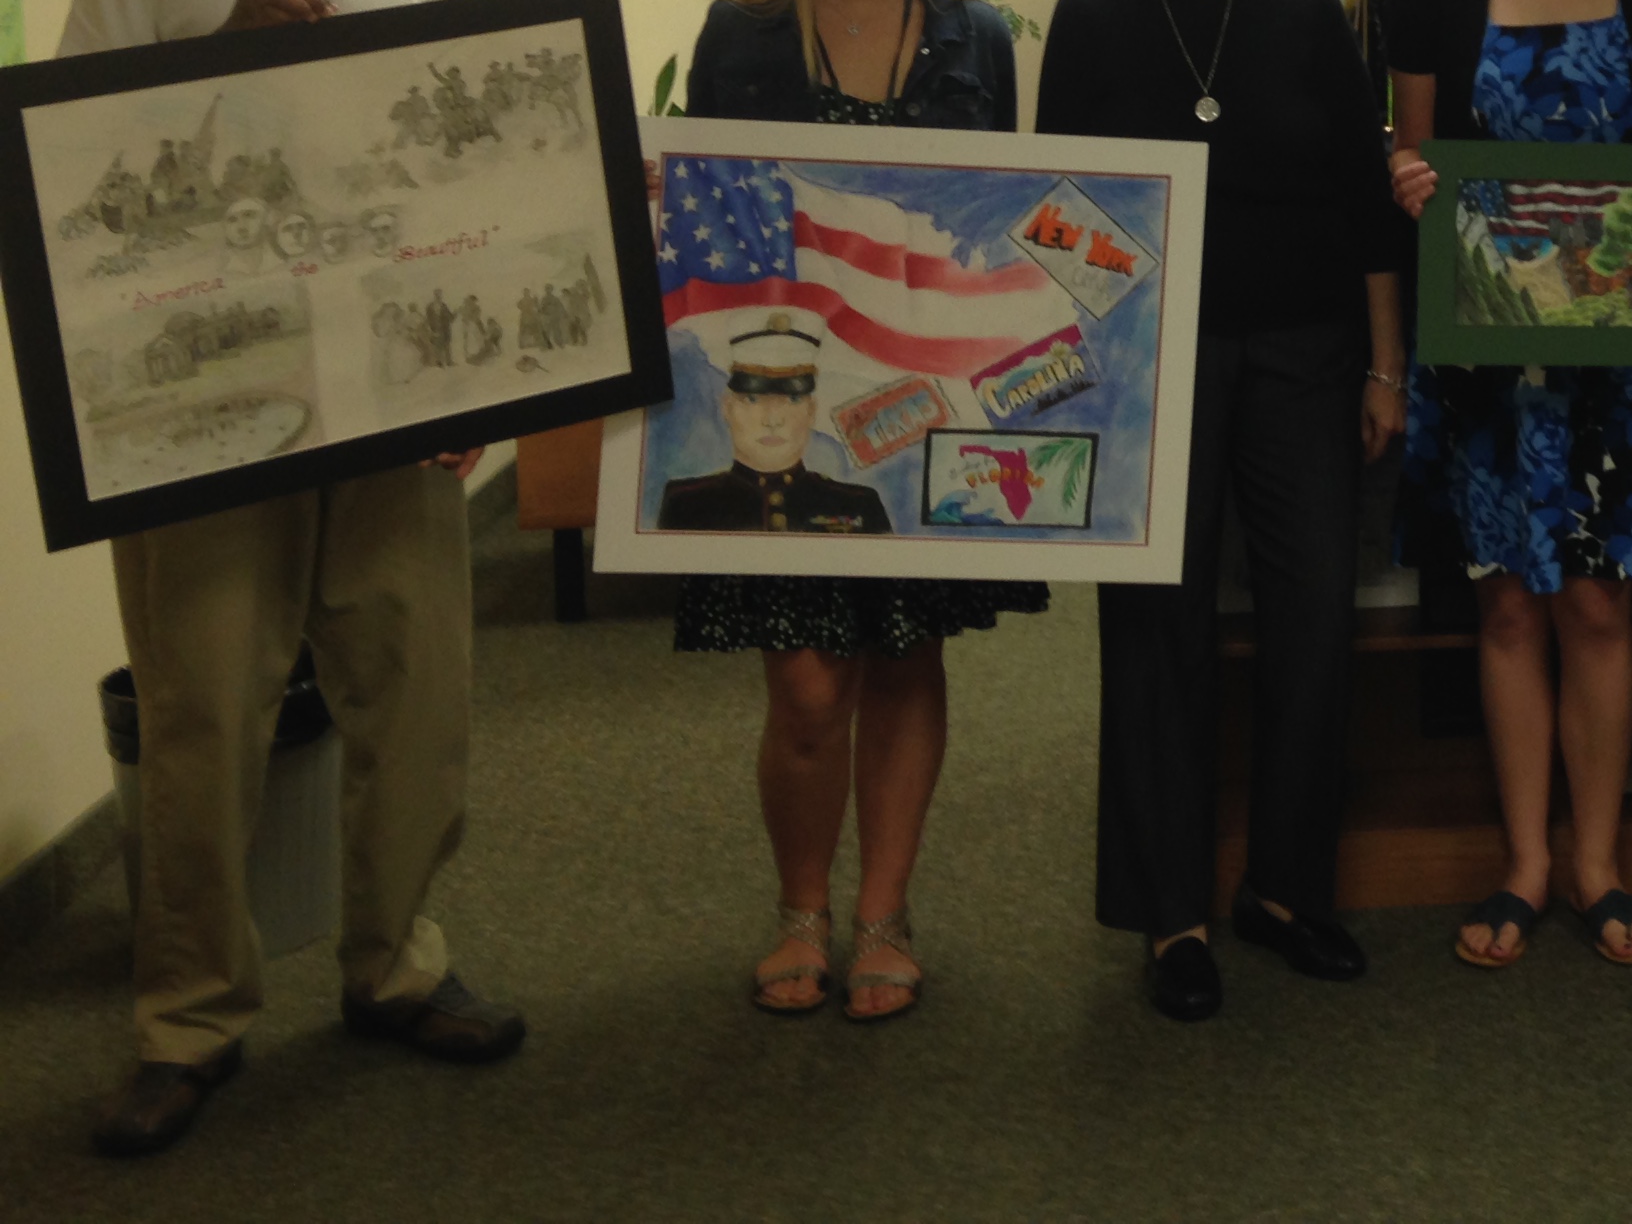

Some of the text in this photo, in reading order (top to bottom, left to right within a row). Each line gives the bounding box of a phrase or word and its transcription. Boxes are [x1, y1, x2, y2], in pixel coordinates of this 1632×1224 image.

[1023, 203, 1138, 277] NEW YORK
[982, 354, 1085, 419] CAROLINA
